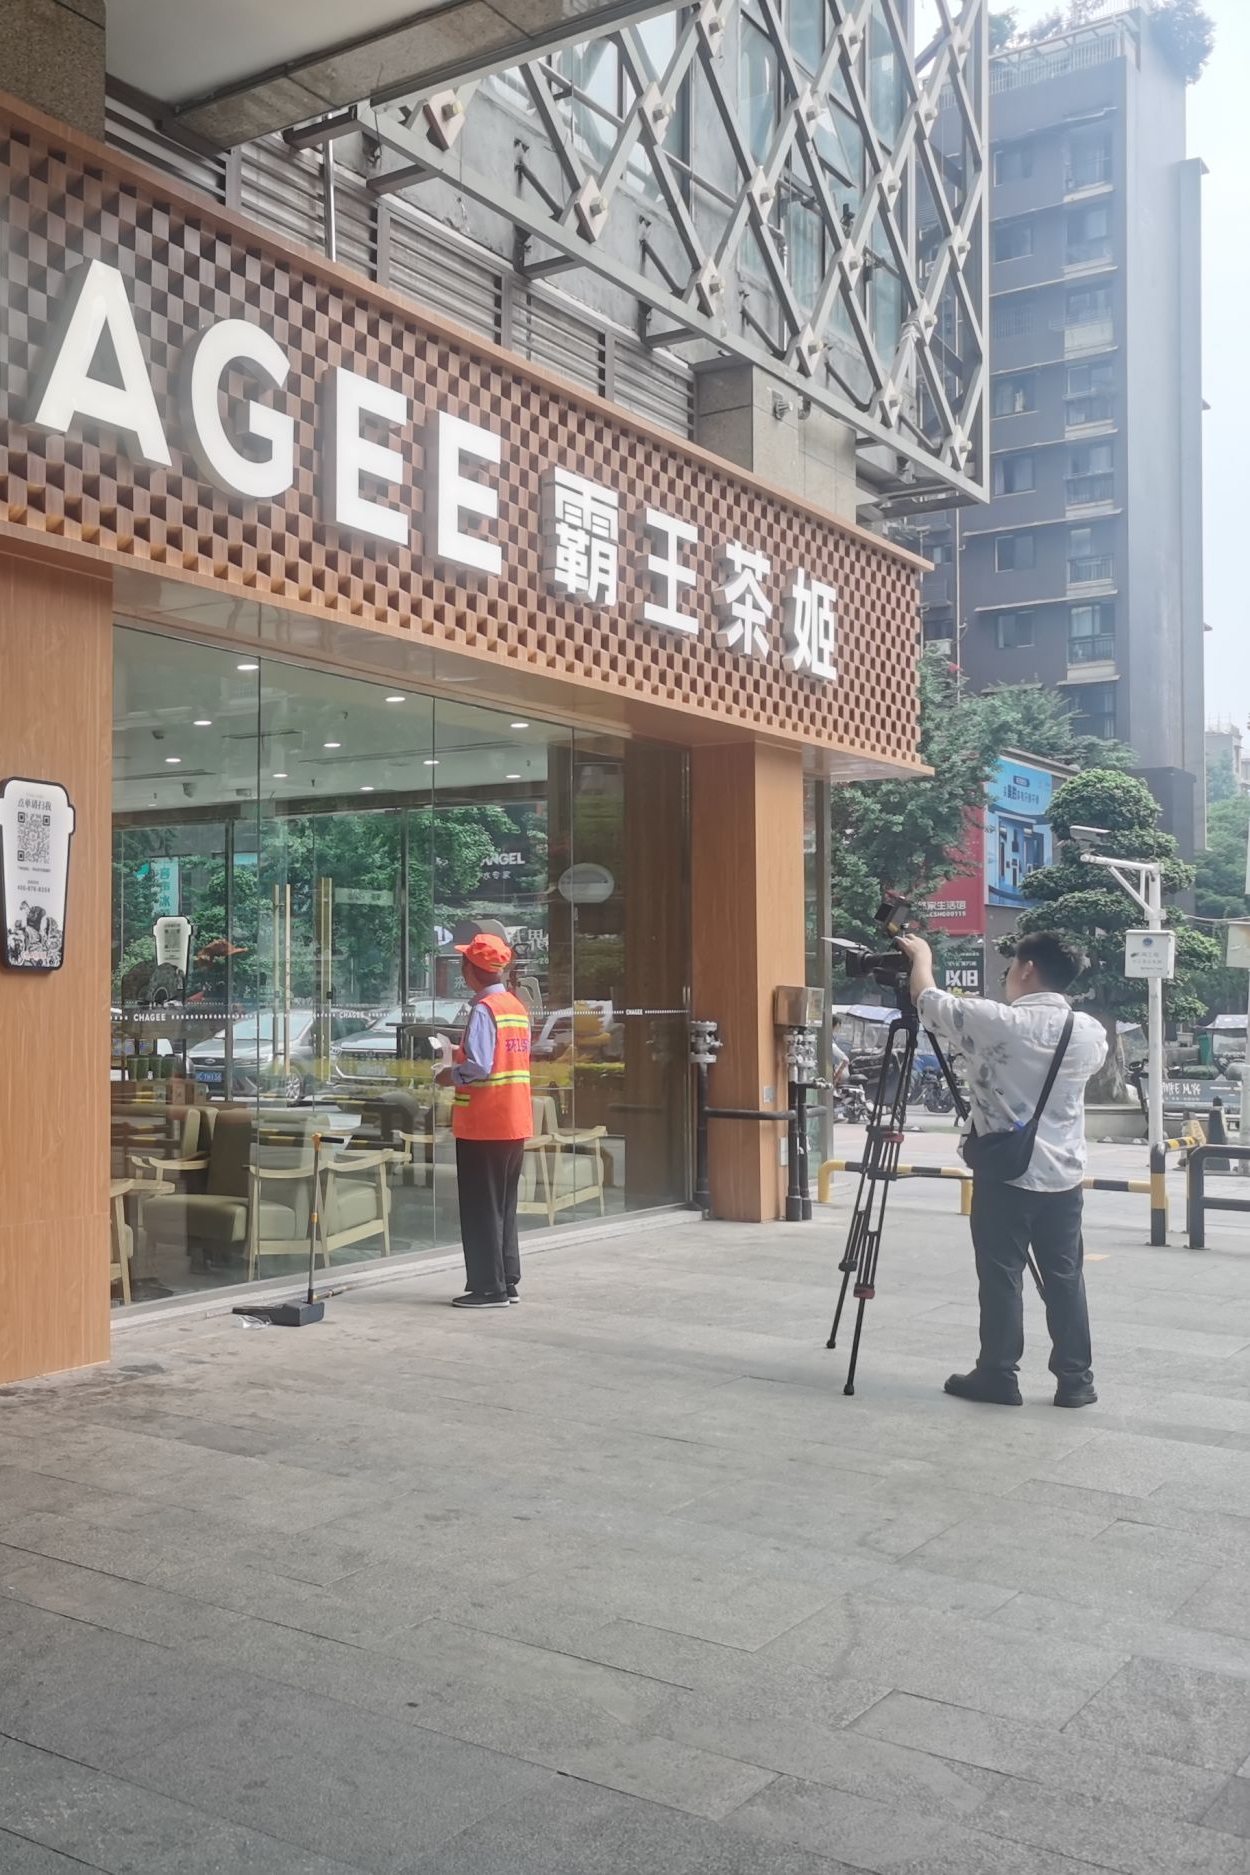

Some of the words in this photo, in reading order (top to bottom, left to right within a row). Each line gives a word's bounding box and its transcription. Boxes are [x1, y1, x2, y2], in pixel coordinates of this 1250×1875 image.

[554, 466, 839, 681] 霸王茶姬
[946, 969, 978, 986] 以旧
[133, 1013, 166, 1021] CHAGEE
